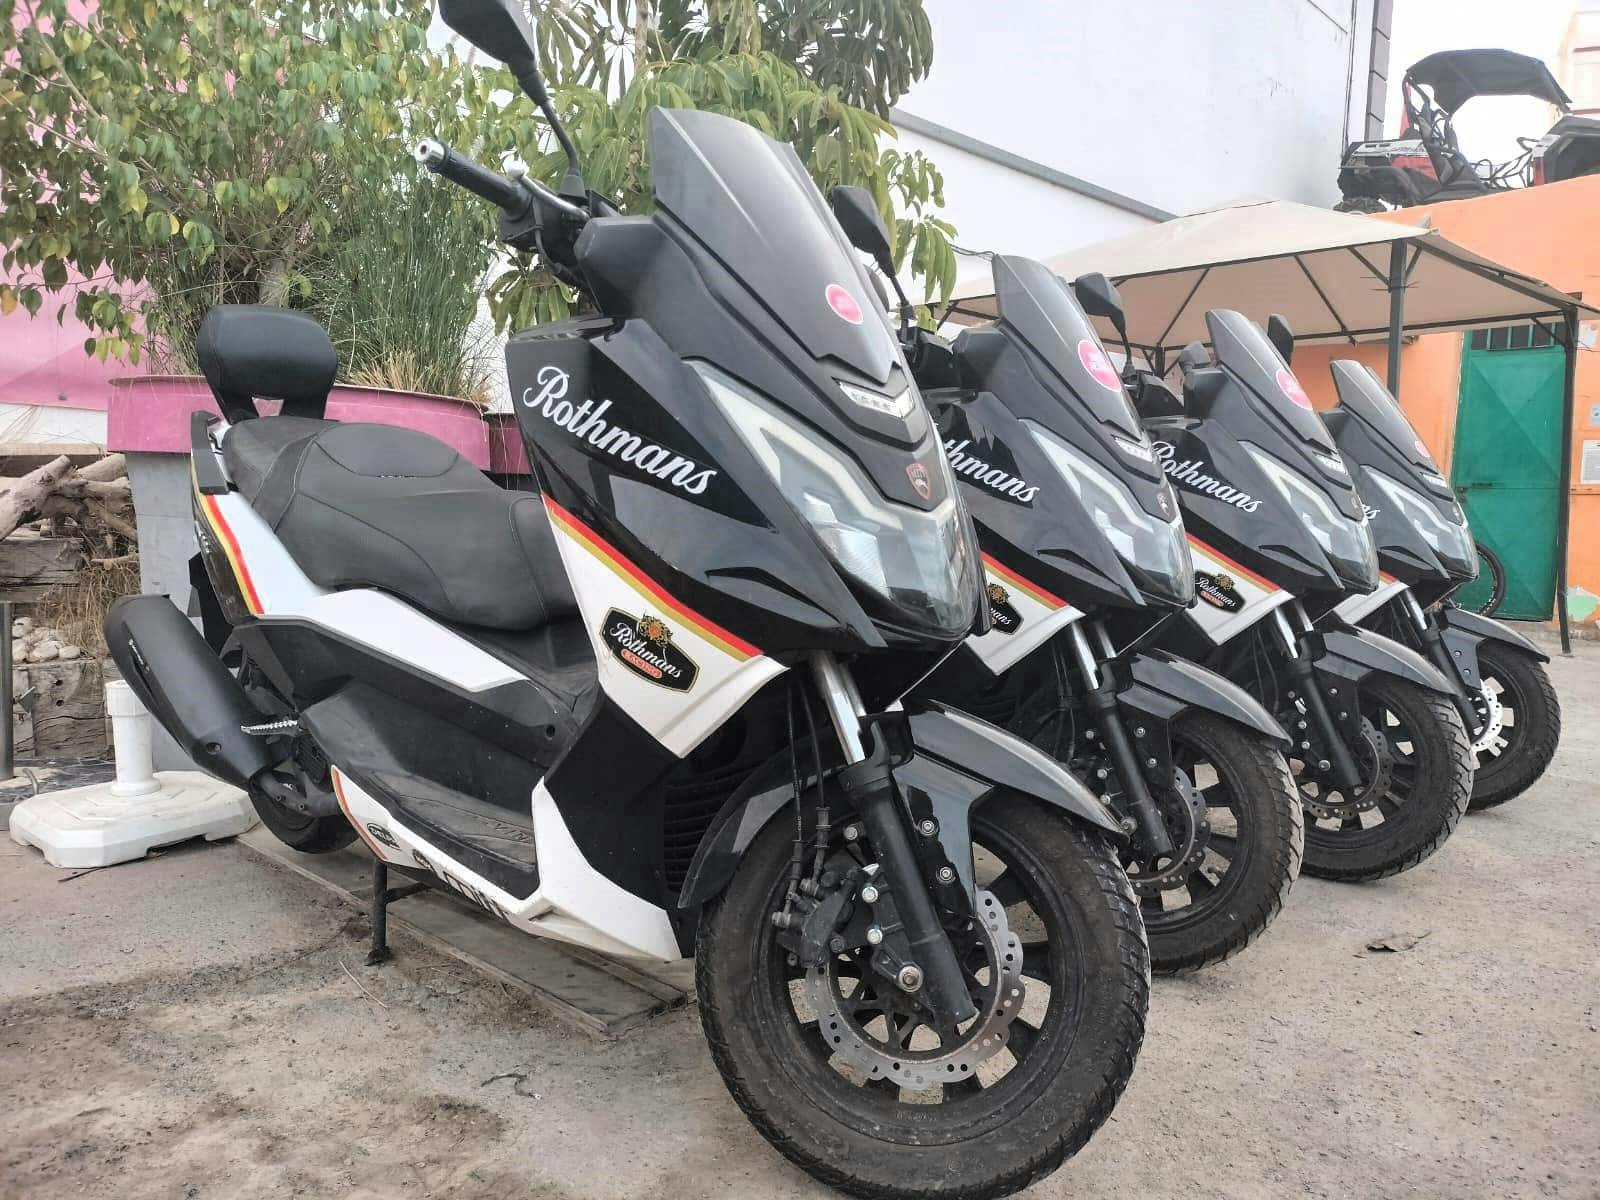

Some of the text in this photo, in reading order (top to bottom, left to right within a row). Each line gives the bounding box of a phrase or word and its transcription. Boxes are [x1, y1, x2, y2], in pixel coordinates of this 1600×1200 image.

[523, 366, 717, 495] Rothmans
[944, 439, 1040, 502] thmans
[609, 622, 683, 678] Rothmans
